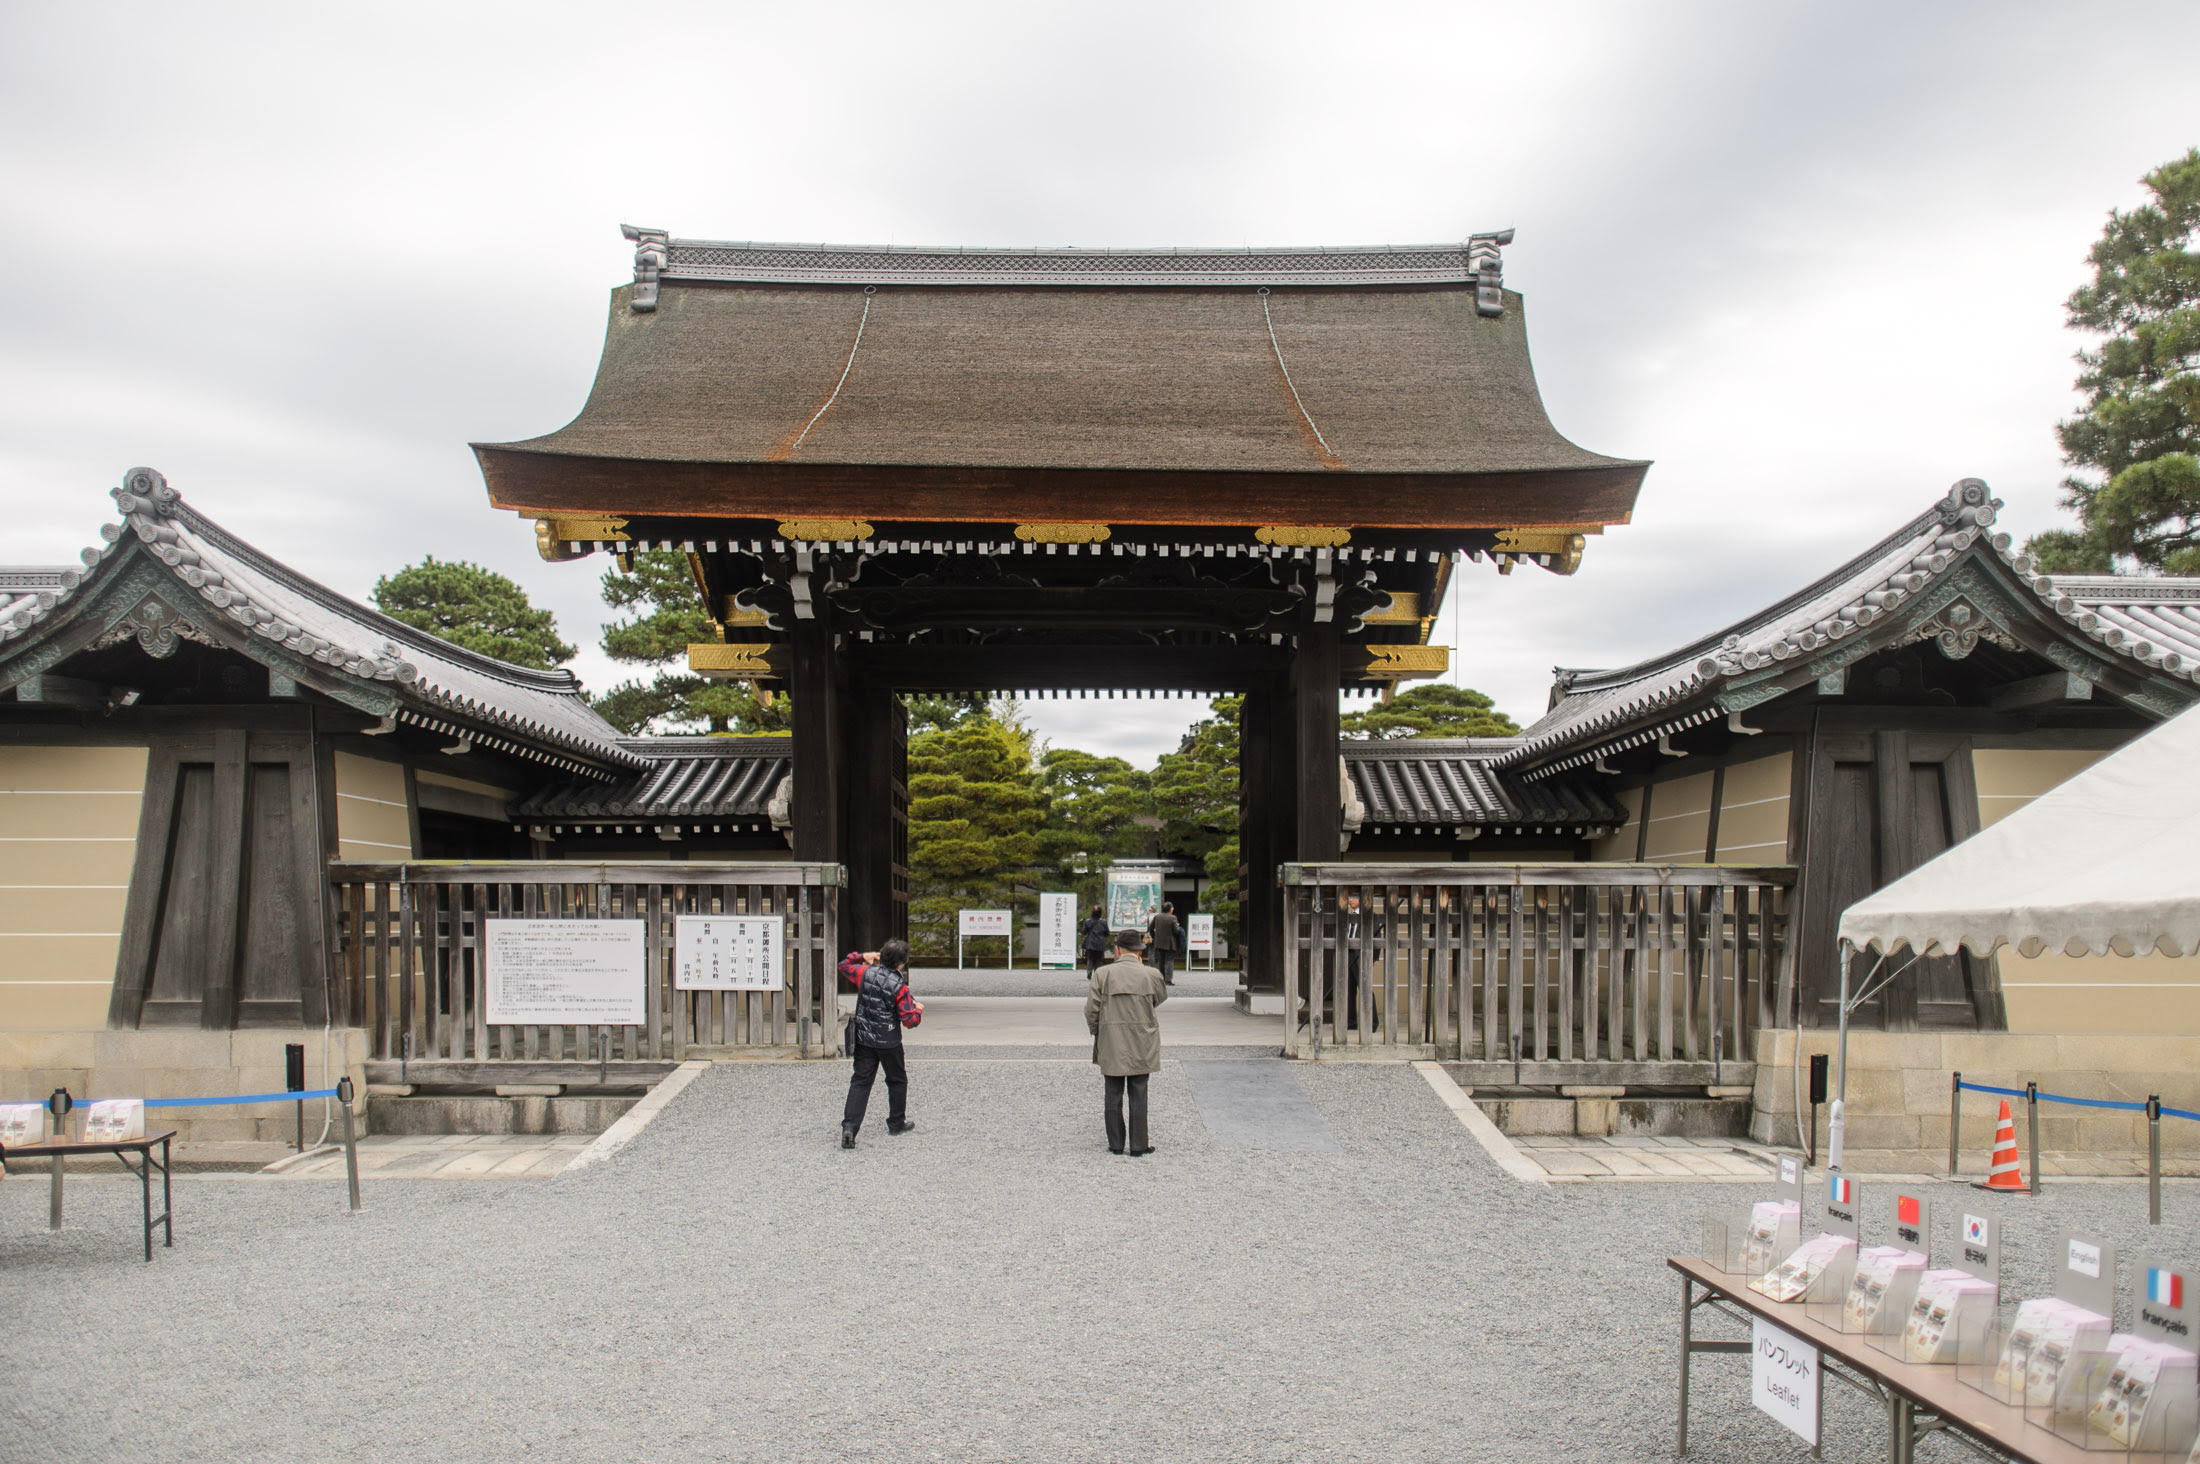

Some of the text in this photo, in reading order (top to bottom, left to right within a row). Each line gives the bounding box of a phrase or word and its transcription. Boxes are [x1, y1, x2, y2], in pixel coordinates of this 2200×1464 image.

[762, 922, 770, 985] 京都御所公開日程
[1828, 1205, 1853, 1222] français
[1965, 1248, 1987, 1267] 한국어
[2071, 1248, 2098, 1265] English
[2142, 1308, 2188, 1336] français
[1759, 1336, 1810, 1379] パンフレット
[1767, 1376, 1800, 1410] Leaflet
